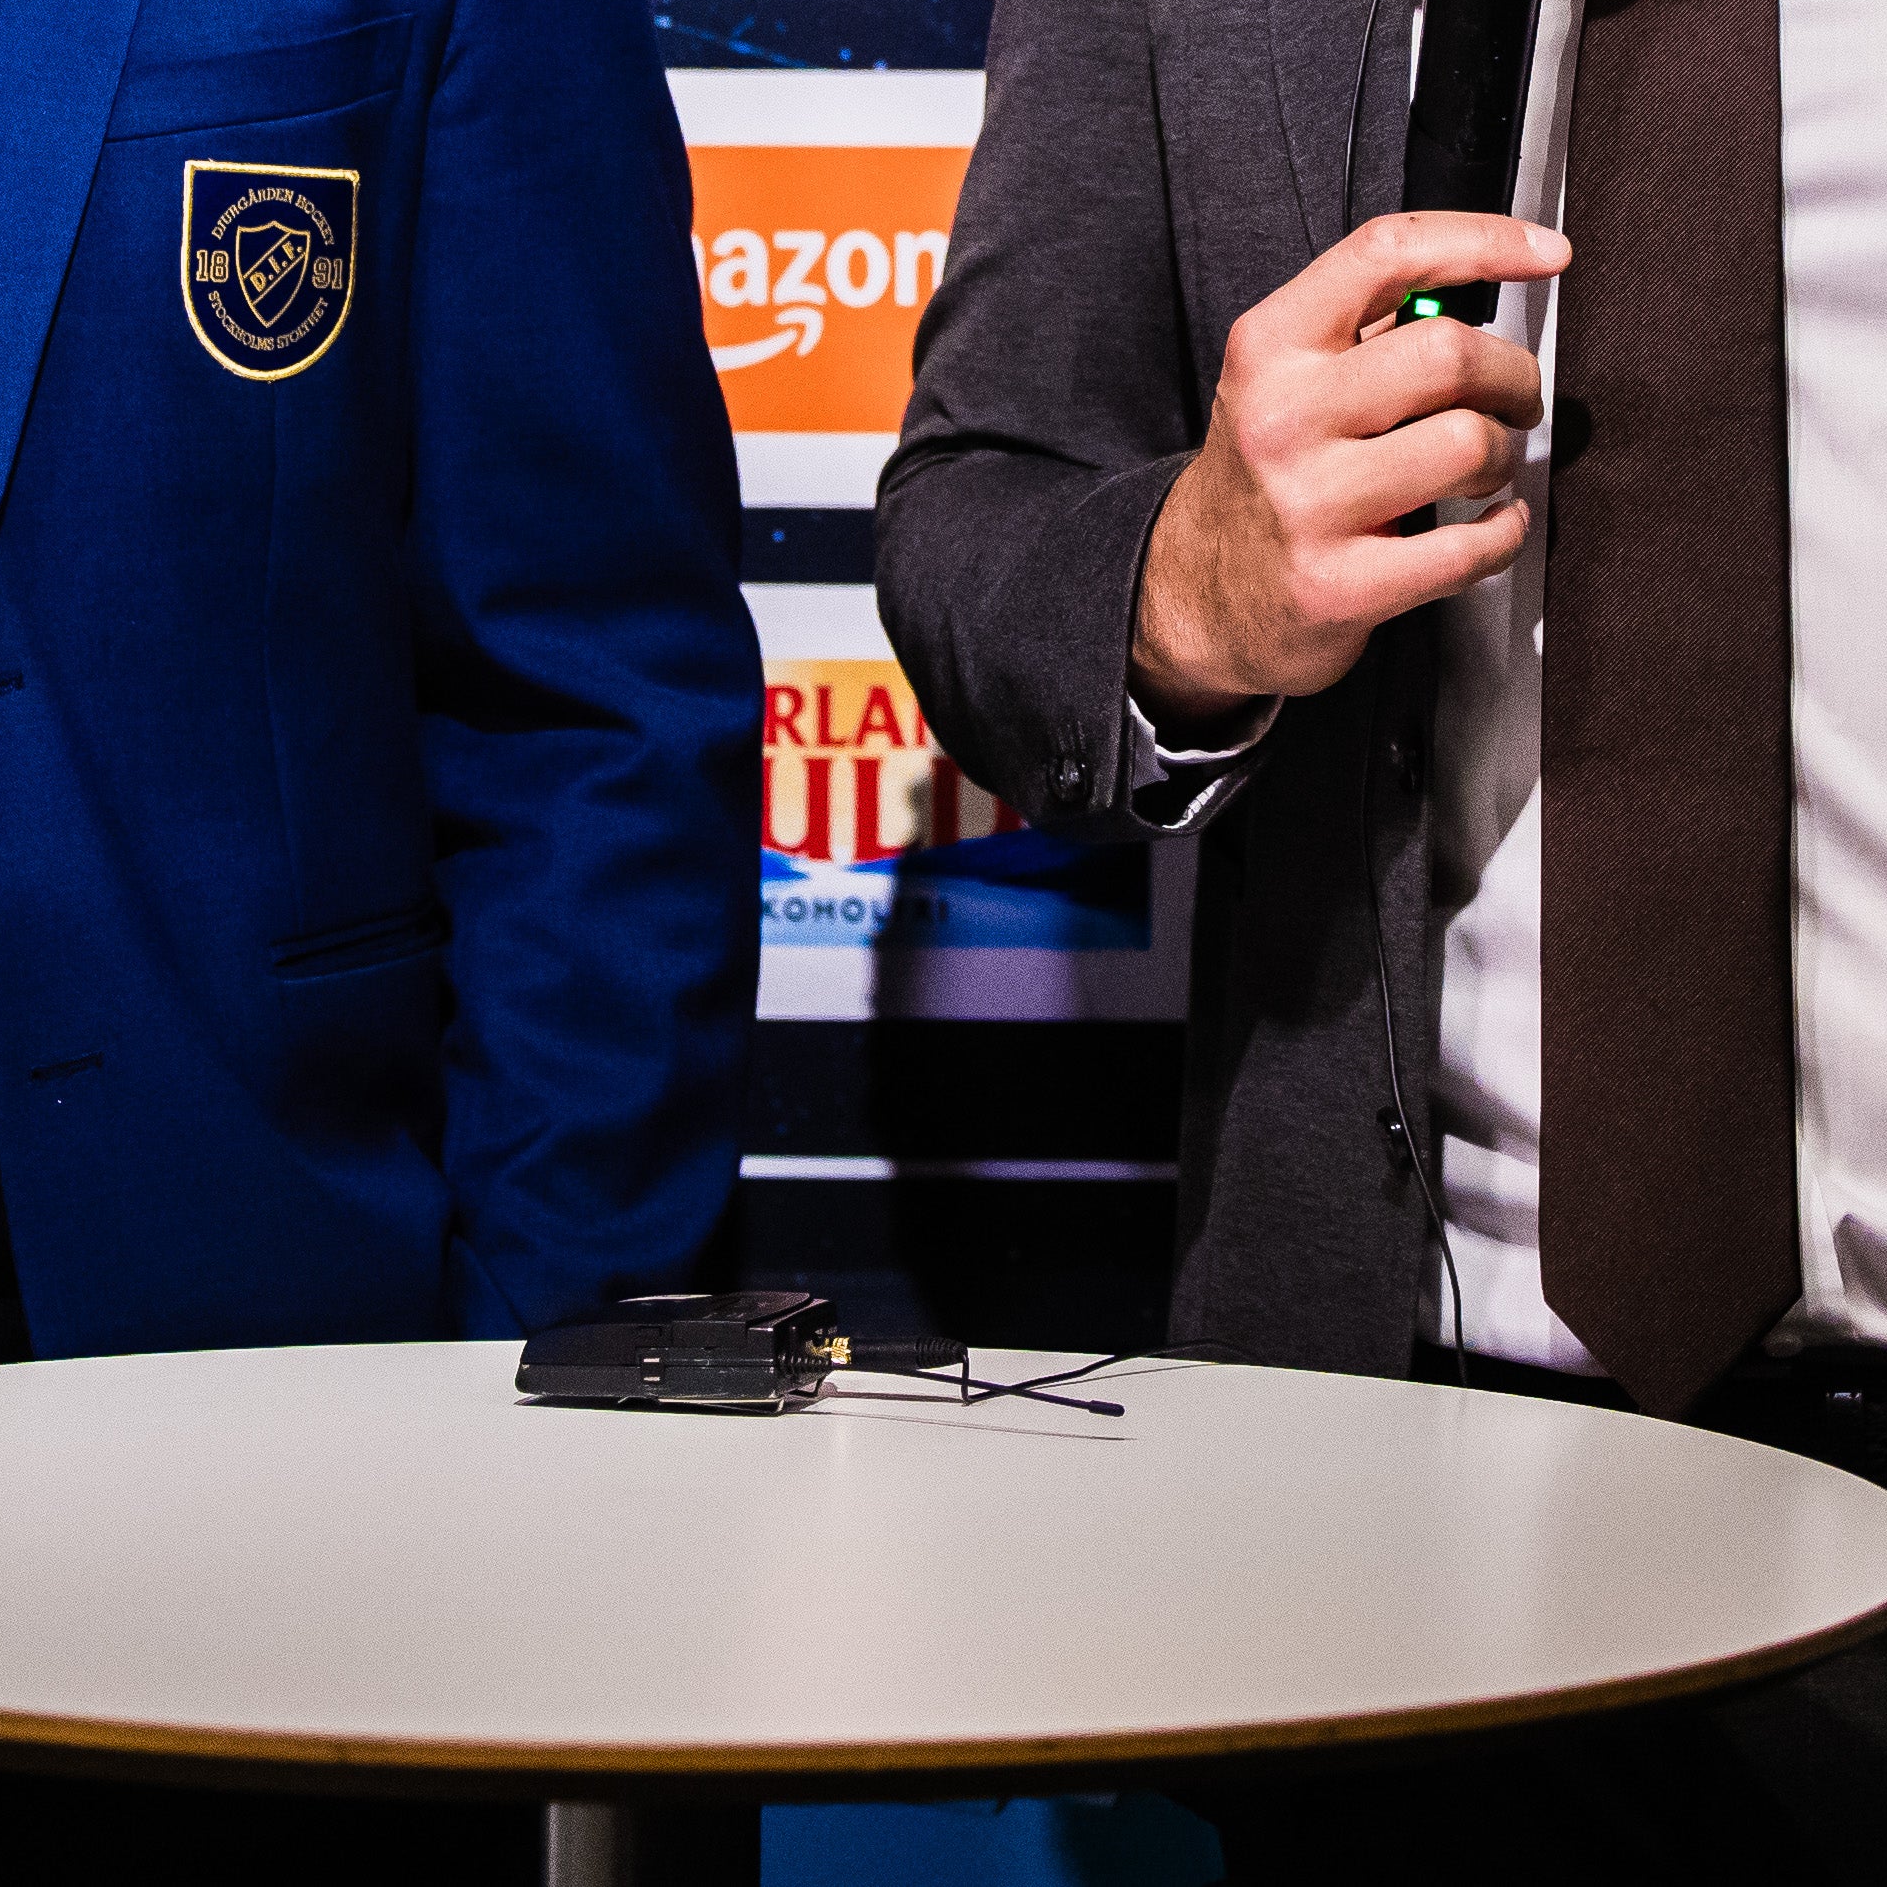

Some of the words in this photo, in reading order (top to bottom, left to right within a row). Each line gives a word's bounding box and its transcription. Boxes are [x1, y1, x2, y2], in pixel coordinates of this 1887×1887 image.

[295, 194, 335, 246] HOCKEY
[196, 249, 229, 283] 18
[312, 257, 343, 290] 91
[208, 290, 275, 351] STOCKHOLMS
